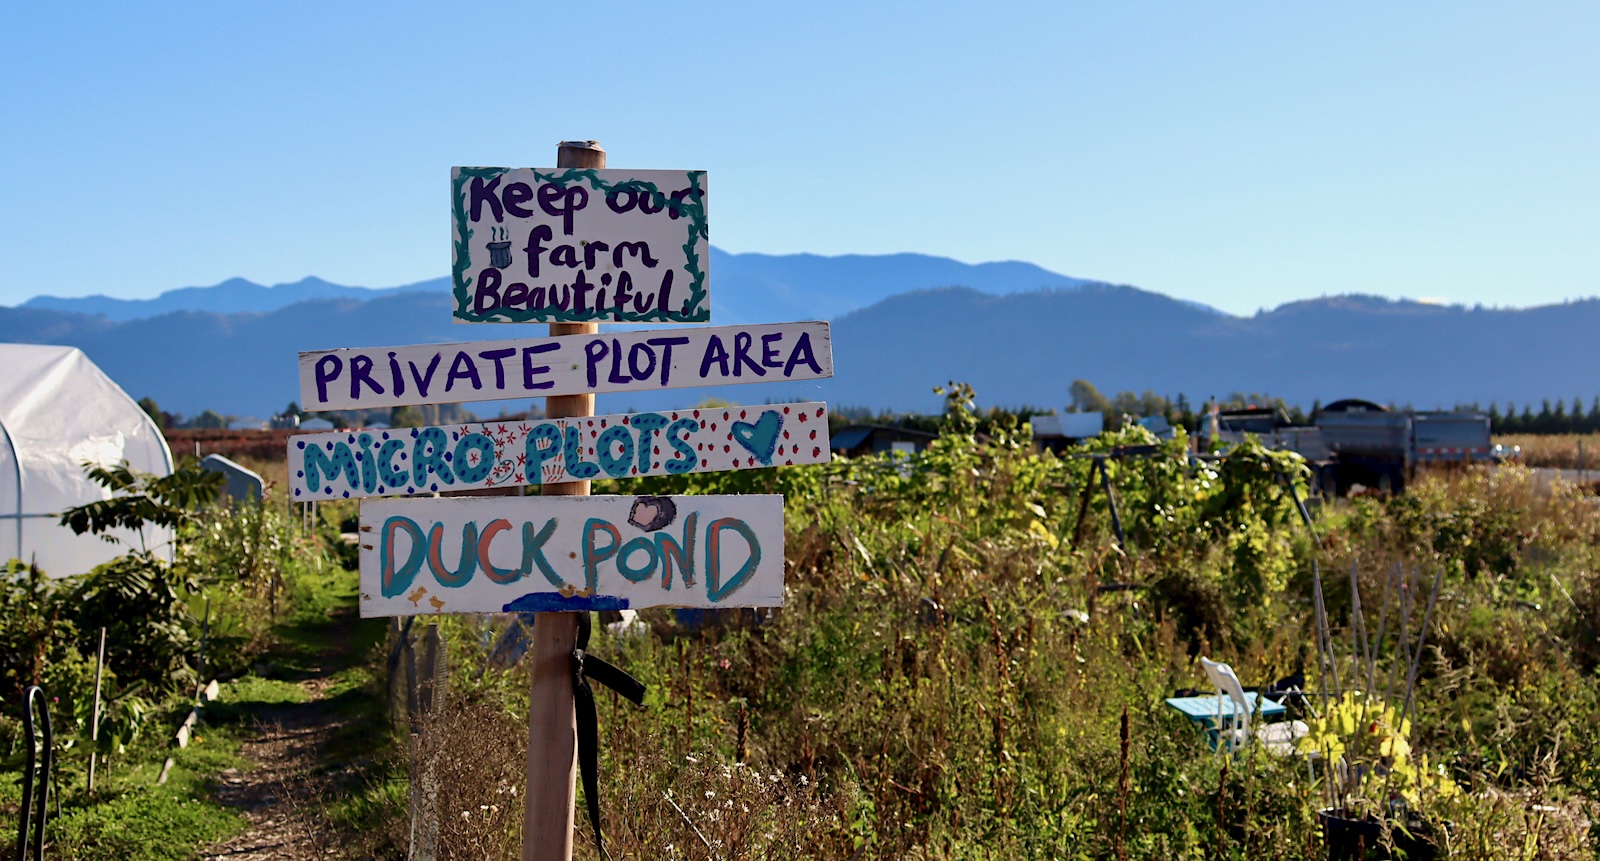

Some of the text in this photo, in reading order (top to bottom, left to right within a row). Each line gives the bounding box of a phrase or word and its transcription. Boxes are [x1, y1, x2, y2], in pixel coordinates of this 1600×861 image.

[470, 174, 705, 235] Keep our
[523, 225, 659, 278] farm
[474, 268, 689, 321] Beautiful.
[585, 337, 690, 388] PLOT
[699, 332, 824, 378] AREA
[525, 413, 699, 485] PLOTS
[380, 511, 762, 602] DUCK POND
